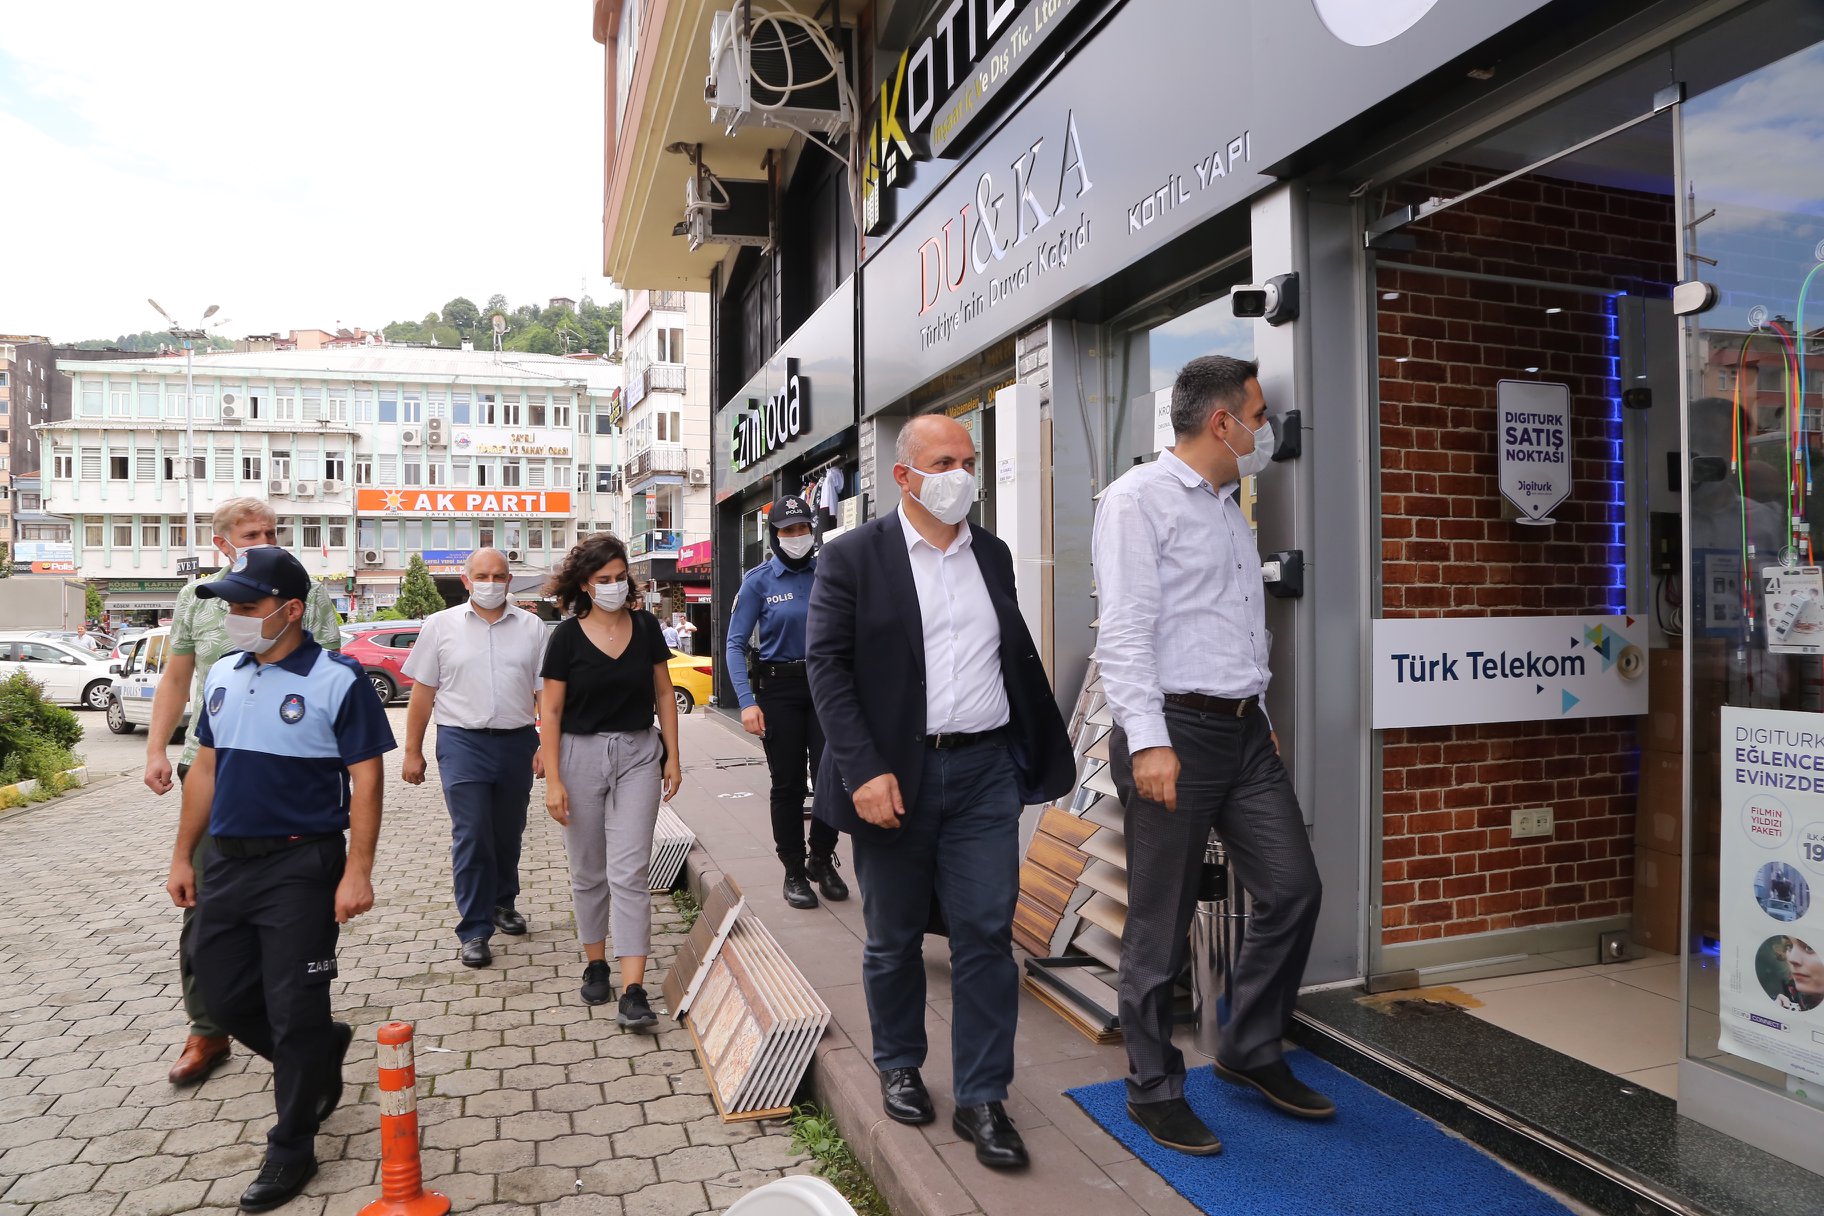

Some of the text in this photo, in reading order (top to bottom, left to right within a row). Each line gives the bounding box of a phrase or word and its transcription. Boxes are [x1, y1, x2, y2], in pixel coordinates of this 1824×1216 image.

[990, 48, 1009, 84] Dış
[1127, 130, 1250, 236] KOTİL YAPI
[918, 108, 1093, 316] DU&KA
[989, 260, 1032, 309] Duvar
[1037, 212, 1092, 276] Kağıdı
[1505, 411, 1563, 426] DIGITURK
[1505, 426, 1564, 451] SATIŞ
[1505, 448, 1564, 463] NOKTASI
[413, 491, 546, 512] AK PARTİ
[1390, 650, 1585, 683] Türk Telekom
[1736, 726, 1824, 749] DIGITURK
[1735, 744, 1824, 772] EĞLENCE
[1751, 1014, 1781, 1029] CONNECT
